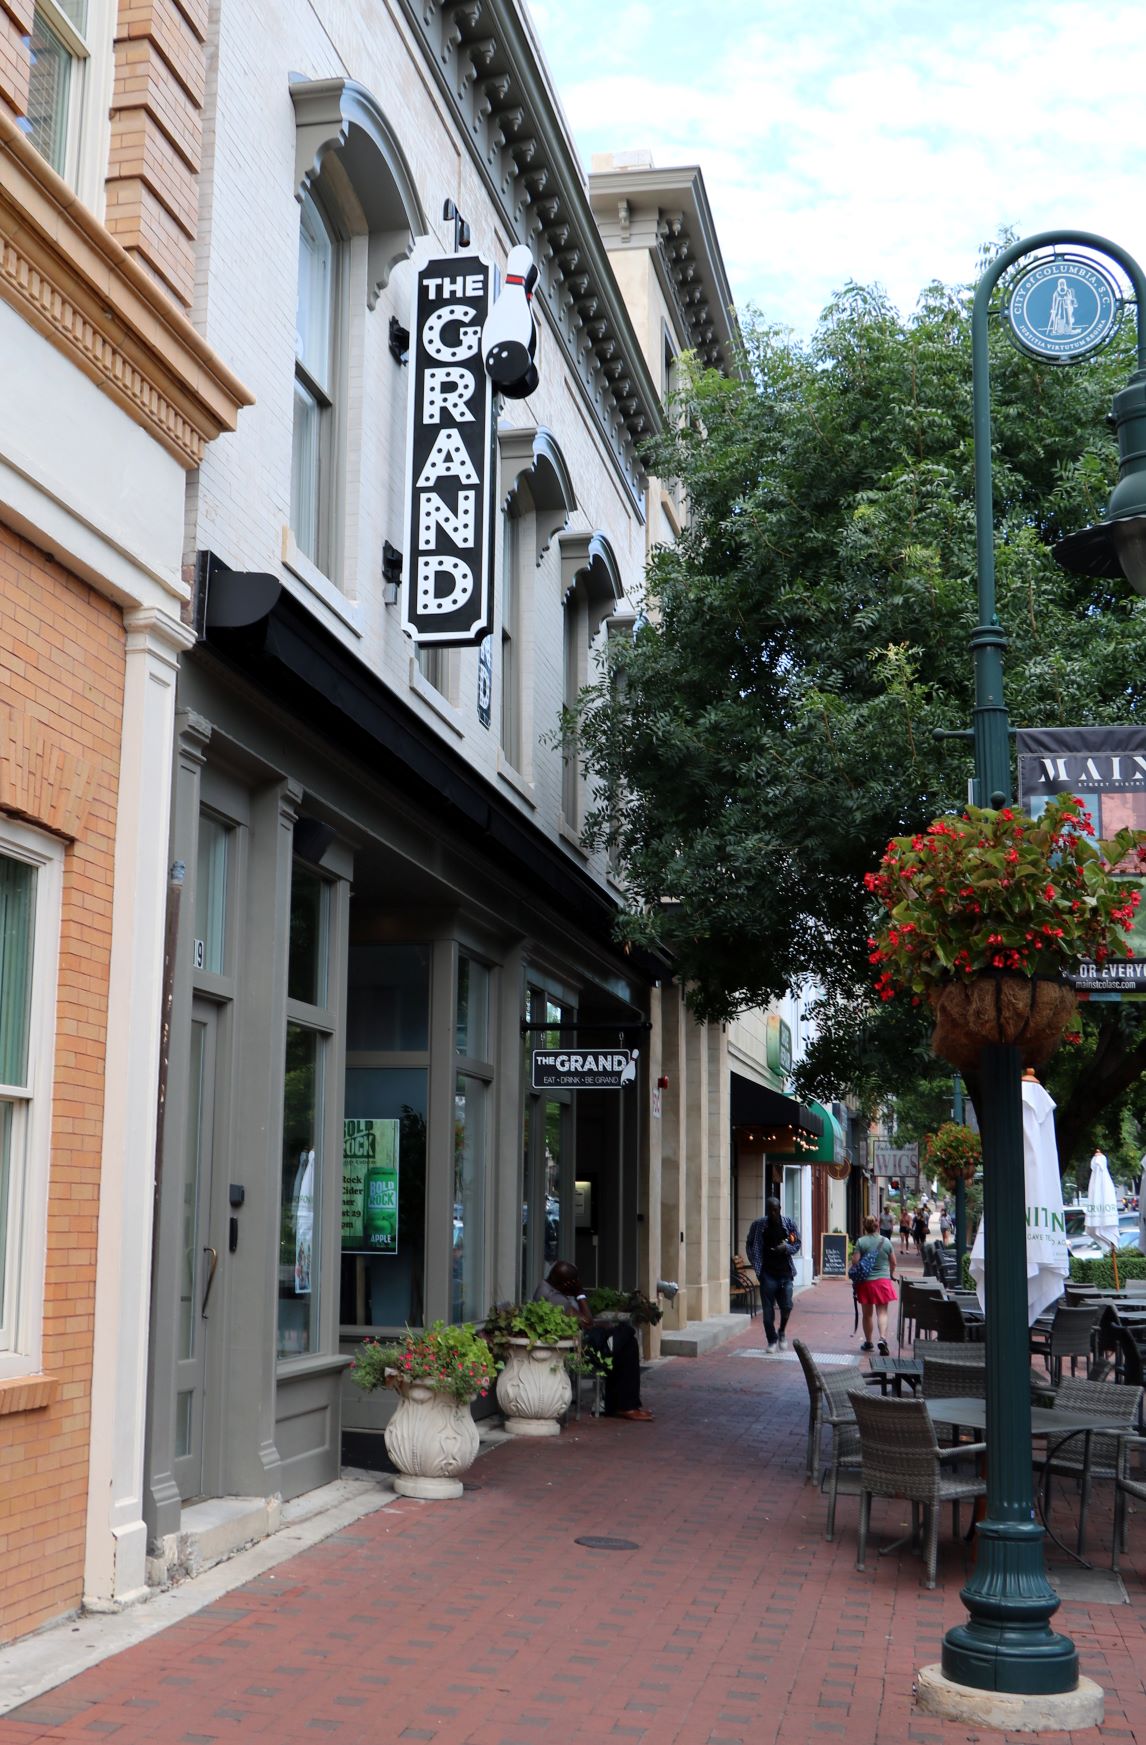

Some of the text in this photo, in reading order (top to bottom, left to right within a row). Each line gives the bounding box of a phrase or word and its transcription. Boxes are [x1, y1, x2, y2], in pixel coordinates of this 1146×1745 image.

[422, 274, 484, 300] THE
[1014, 289, 1027, 315] CITY
[416, 304, 482, 615] GRAND
[1073, 962, 1146, 978] OR EVERY
[536, 1055, 627, 1072] THE GRAND
[594, 1076, 619, 1084] GRAND
[876, 1153, 918, 1176] WIGS
[370, 1181, 394, 1194] BOLD
[371, 1234, 392, 1243] APPLE
